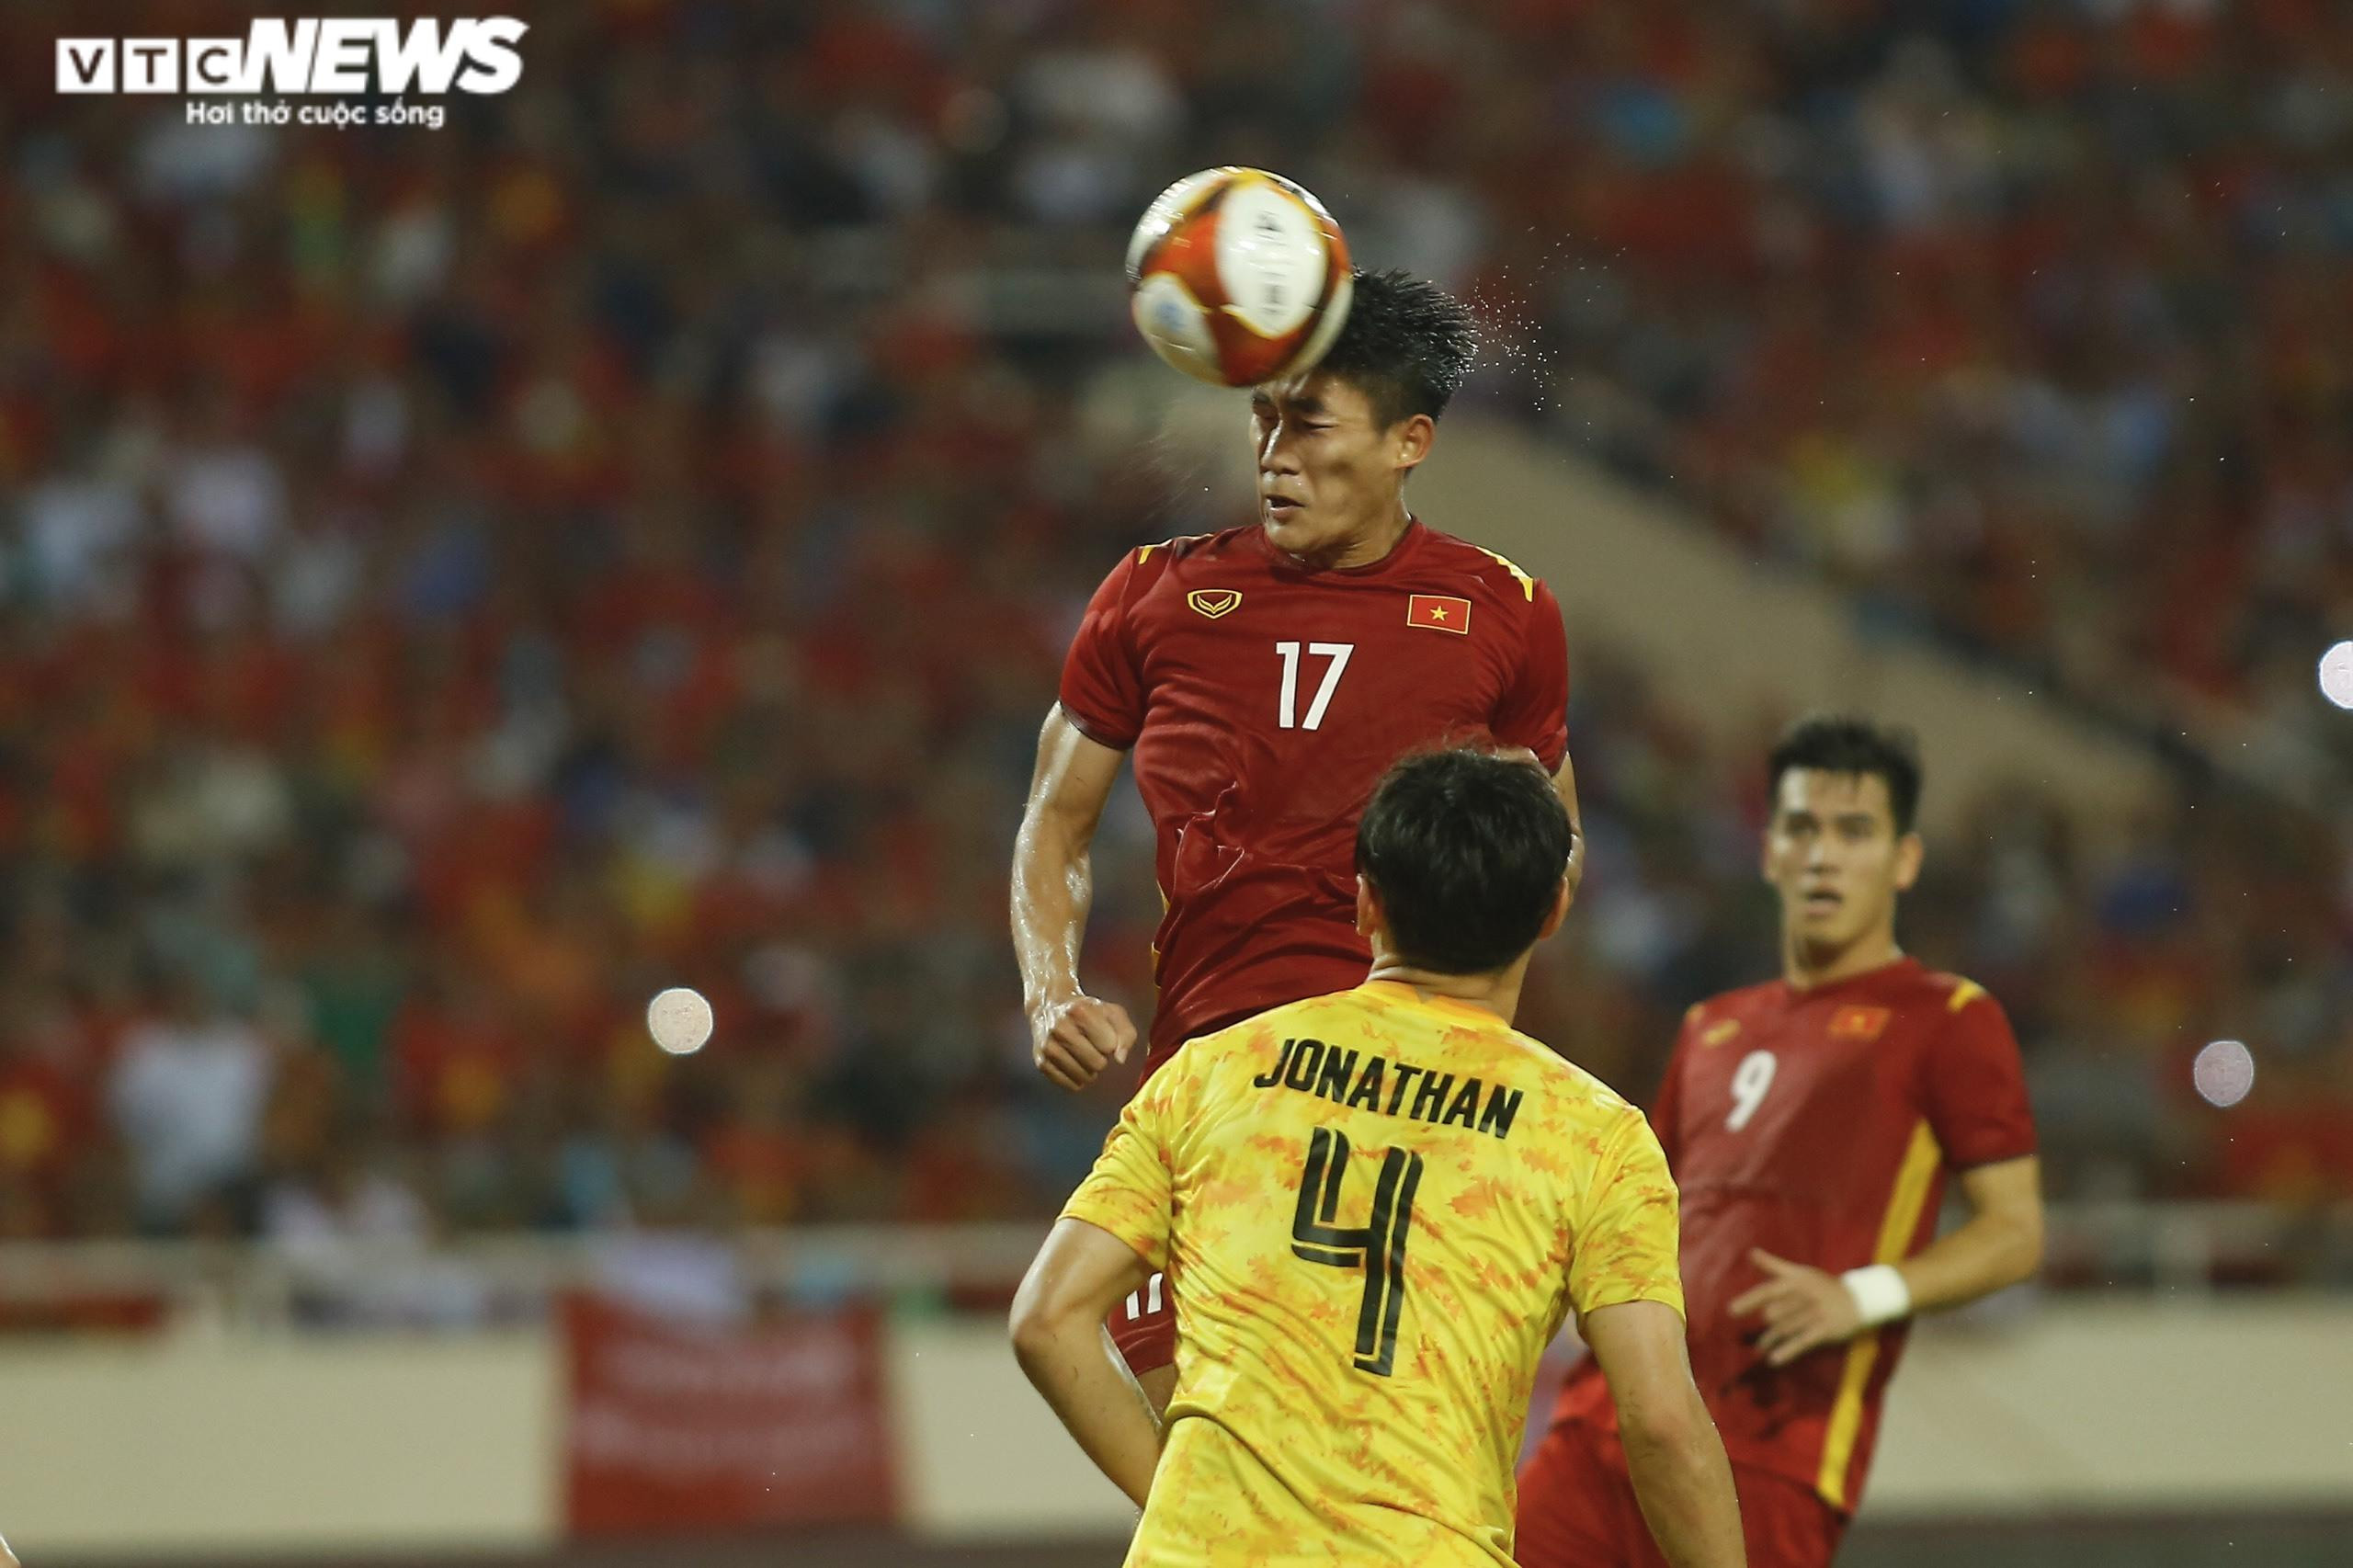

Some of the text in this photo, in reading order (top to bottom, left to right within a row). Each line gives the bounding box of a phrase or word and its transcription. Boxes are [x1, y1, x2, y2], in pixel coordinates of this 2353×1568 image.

[1276, 642, 1355, 731] 17
[1254, 1039, 1524, 1140] JONATHAN
[1724, 1050, 1777, 1132] 9
[1291, 1126, 1425, 1377] 4
